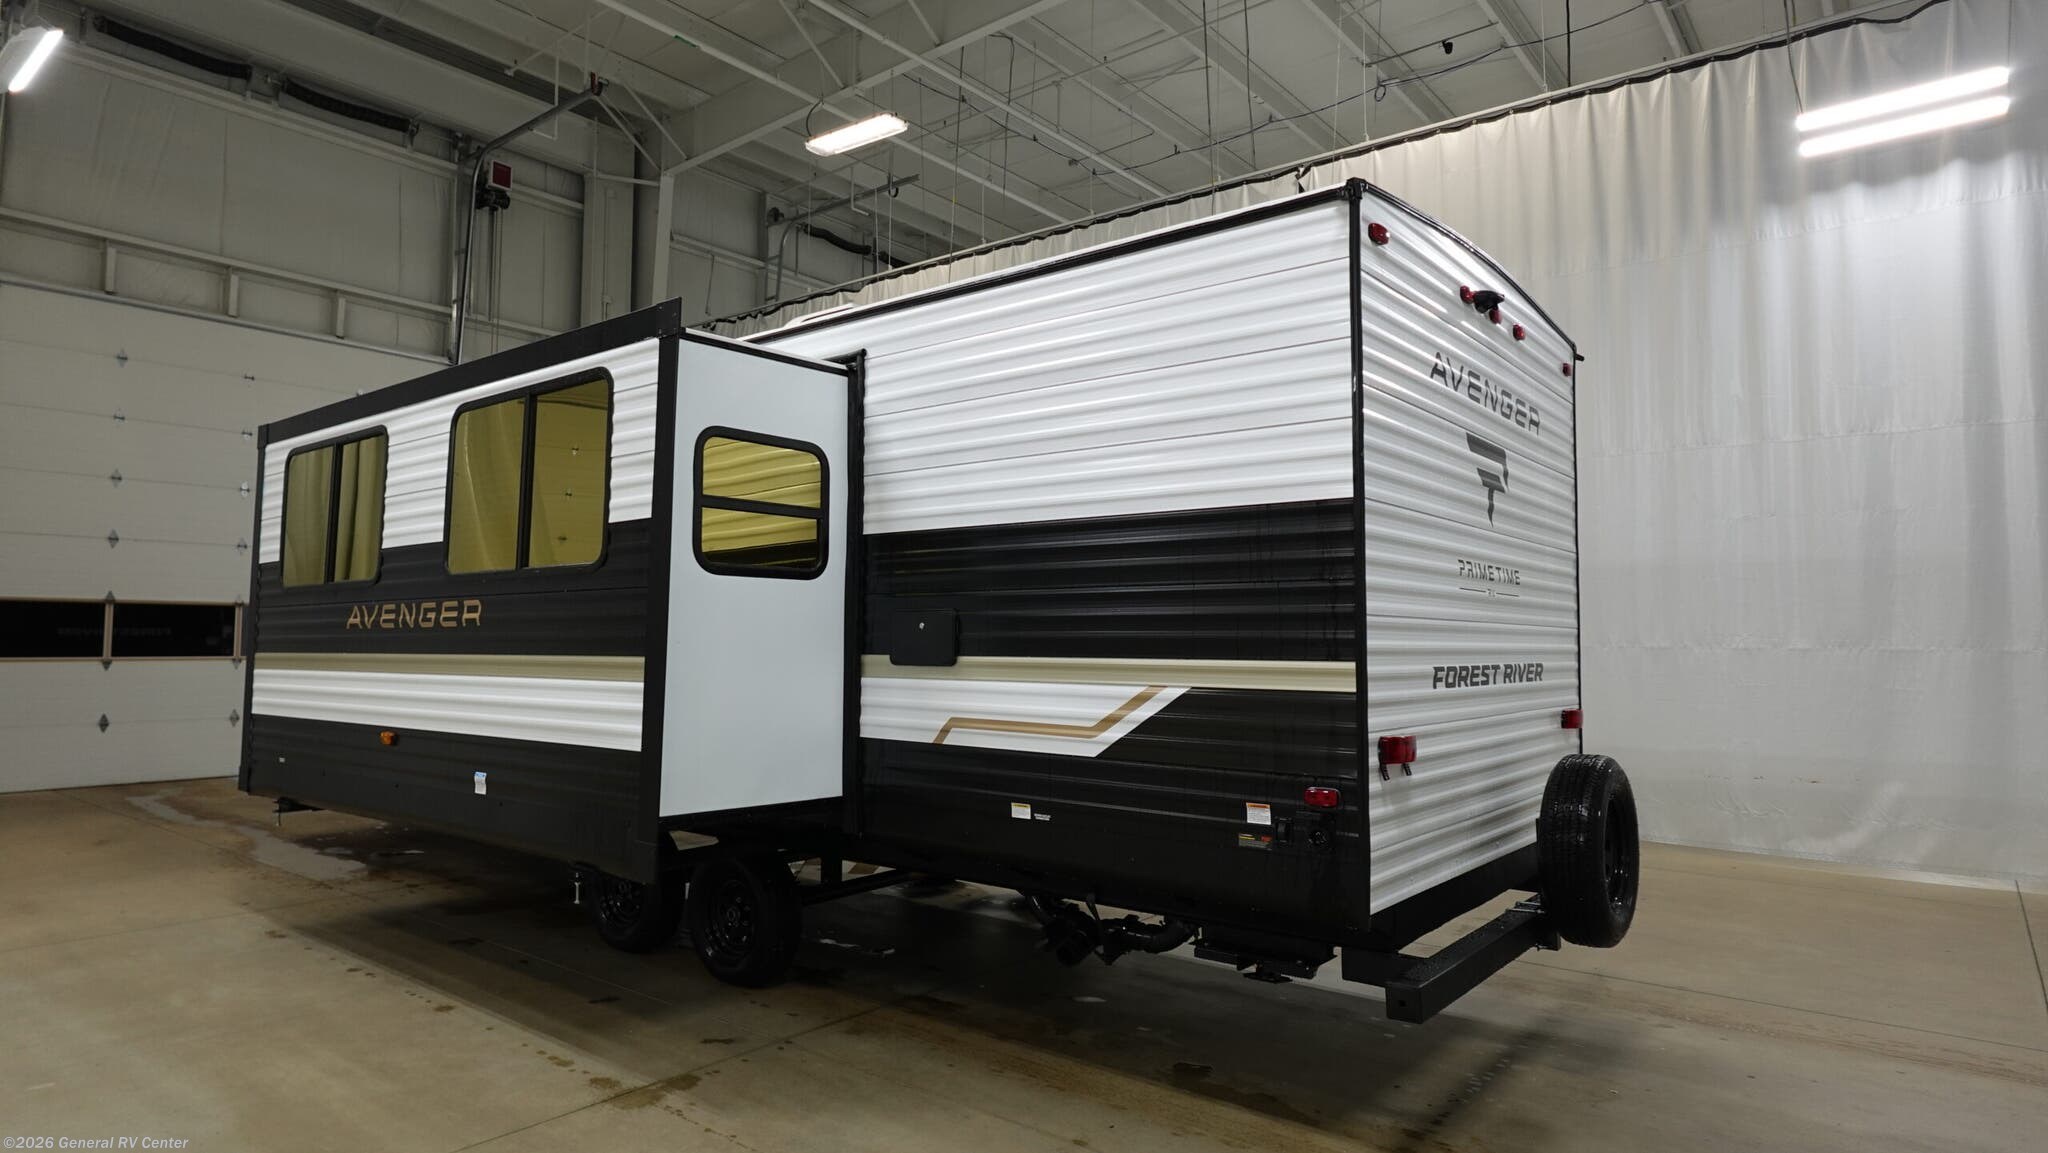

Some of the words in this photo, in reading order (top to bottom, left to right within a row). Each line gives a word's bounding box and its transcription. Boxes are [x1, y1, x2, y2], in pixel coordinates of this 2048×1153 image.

[1430, 351, 1541, 436] AVENGER
[346, 599, 482, 629] AVENGER
[1432, 664, 1501, 689] FOREST
[1503, 663, 1544, 684] RIVER
